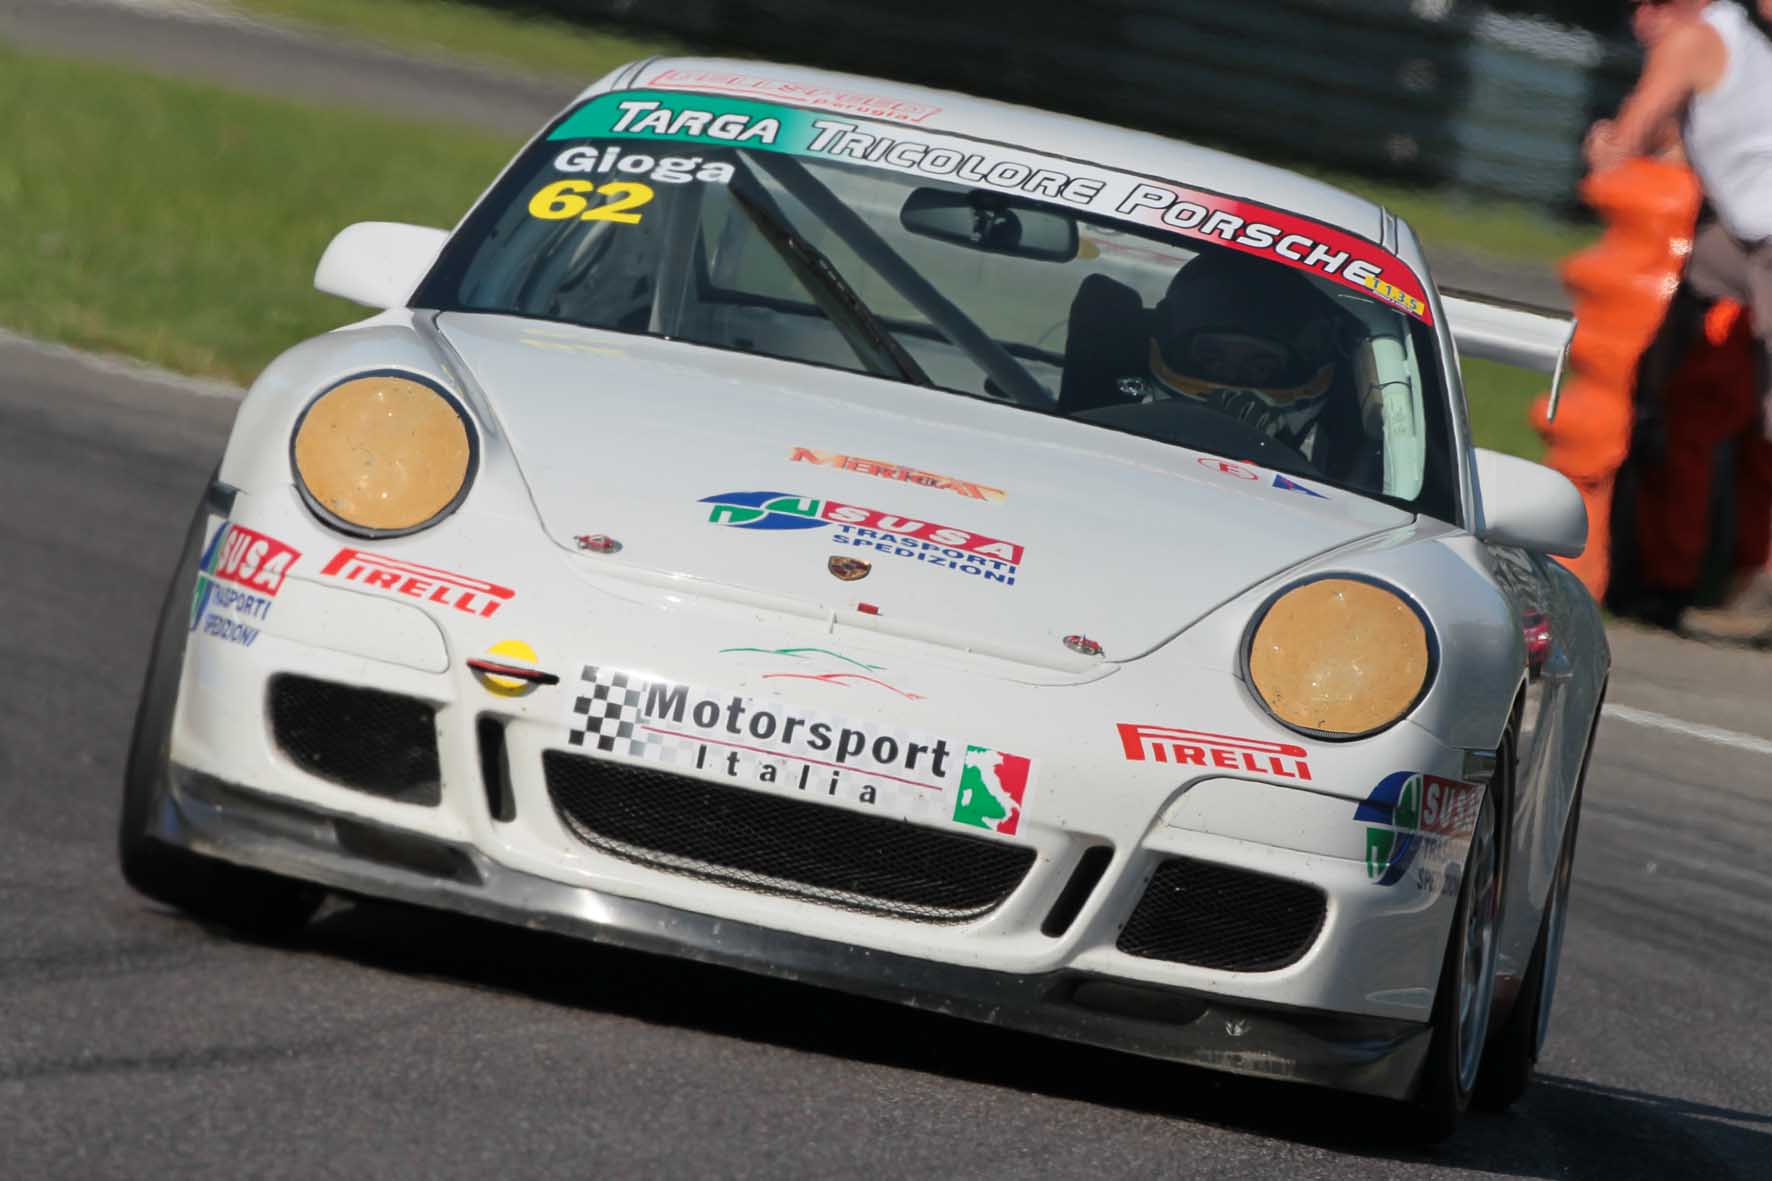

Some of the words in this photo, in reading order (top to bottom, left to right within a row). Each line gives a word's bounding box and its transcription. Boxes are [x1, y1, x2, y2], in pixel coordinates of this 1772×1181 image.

[528, 180, 655, 224] 62
[611, 101, 781, 145] TARGA
[808, 119, 1107, 205] TRICOLORE
[1117, 183, 1384, 287] PORSCHE
[827, 506, 1016, 561] SUSA
[832, 534, 1016, 586] SPEDIZIONI
[837, 524, 1017, 575] TRASPORTI
[320, 548, 516, 619] PIRELLI
[643, 681, 952, 778] Motorsport
[1116, 723, 1312, 781] PIRELLI
[696, 744, 877, 804] Italia
